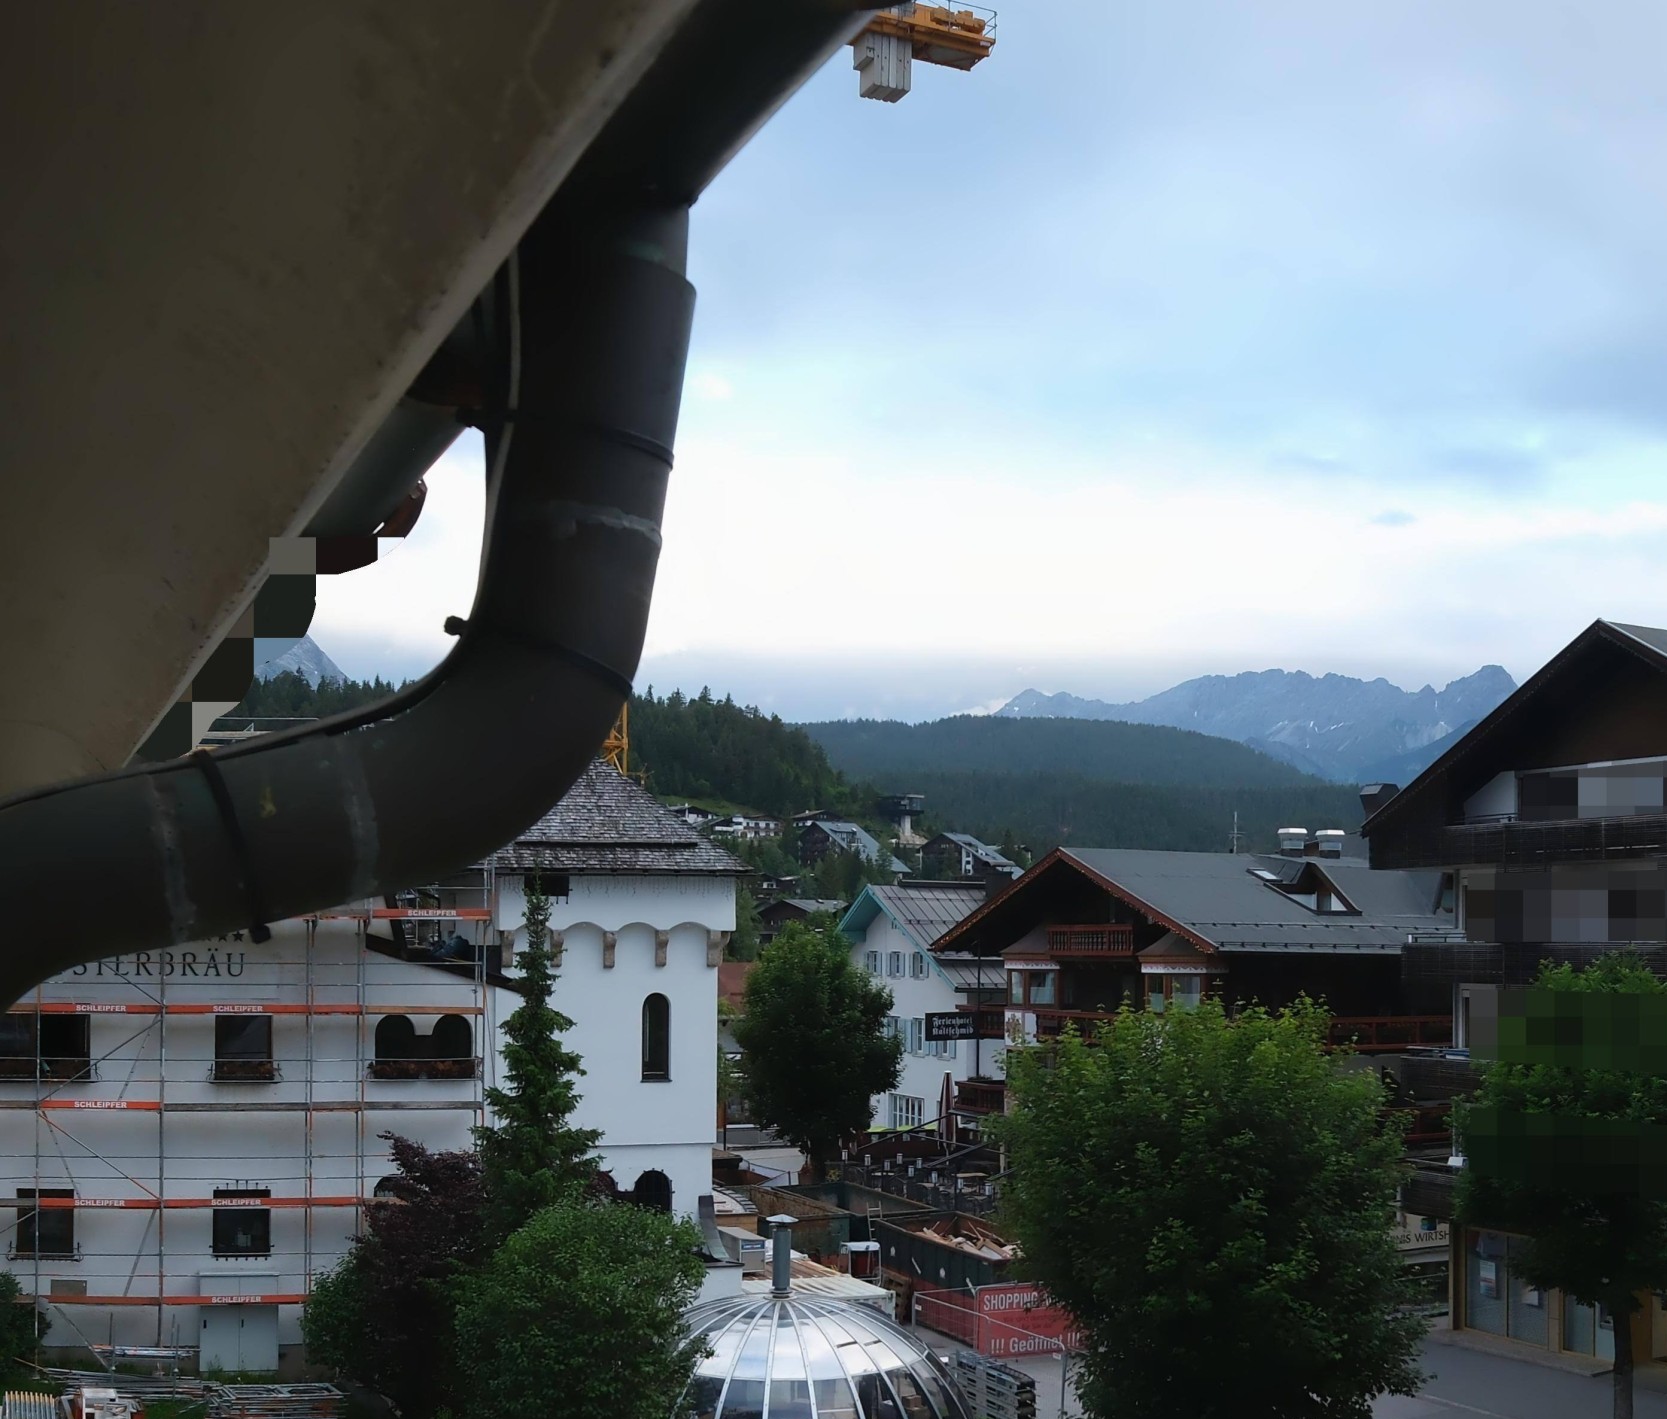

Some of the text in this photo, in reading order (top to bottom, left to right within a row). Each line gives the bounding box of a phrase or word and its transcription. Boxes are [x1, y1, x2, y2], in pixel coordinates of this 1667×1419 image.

[407, 909, 457, 918] SCHLEIPFER
[56, 947, 246, 978] STERBRÄU
[76, 1004, 263, 1013] SCHLEIPFER SCHLEIPFER
[74, 1100, 127, 1109] SCHLEIPFER
[74, 1198, 261, 1207] SCHLEIPFER SCHLEIPFER
[211, 1295, 261, 1304] SCHLEIPFER
[983, 1292, 1038, 1311] SHOPPING
